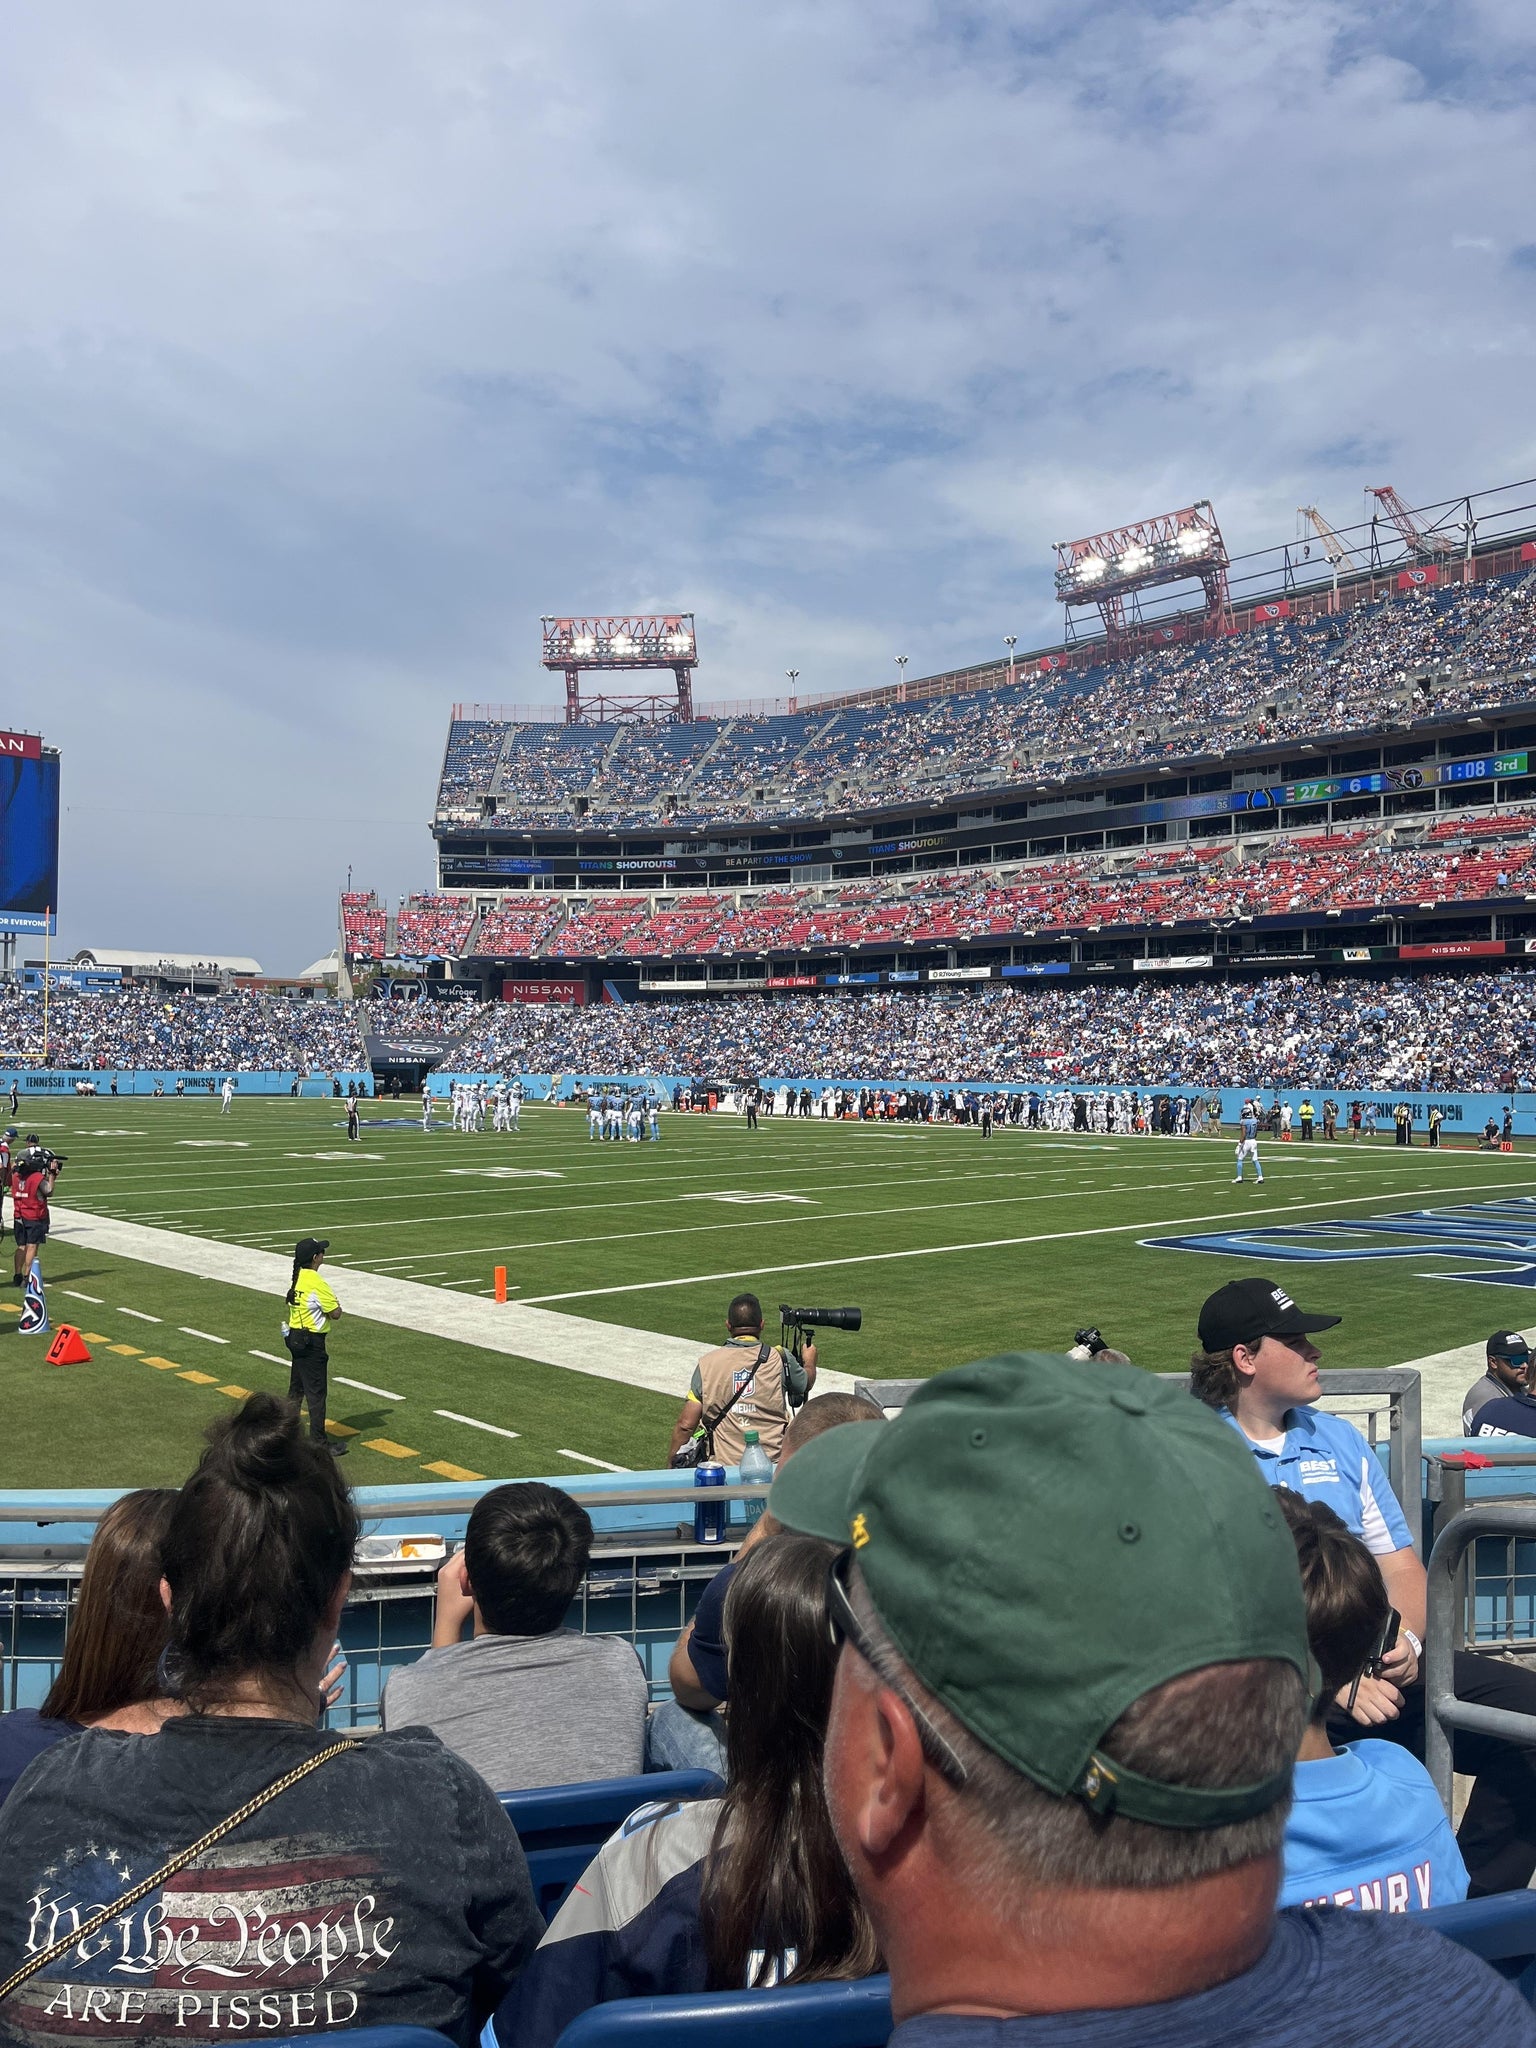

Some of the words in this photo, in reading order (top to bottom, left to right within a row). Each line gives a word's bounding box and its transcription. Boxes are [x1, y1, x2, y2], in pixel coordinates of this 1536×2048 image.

[1435, 760, 1486, 783] 11:08
[1494, 758, 1518, 772] 3rd
[1350, 778, 1361, 793] 6
[1300, 785, 1319, 800] 27
[868, 843, 896, 855] TITANS
[579, 861, 613, 870] TITANS
[616, 860, 677, 870] SHOUTOUTS!
[725, 858, 735, 866] BE
[743, 857, 761, 865] PART
[763, 856, 773, 864] OF
[774, 855, 788, 863] THE
[789, 853, 813, 863] SHOW
[1431, 946, 1471, 954] NISSAN
[449, 984, 478, 999] Kroger
[513, 985, 574, 994] NISSAN
[26, 1076, 65, 1088] TENNESSEE
[182, 1077, 216, 1087] TENNESS
[1502, 1143, 1511, 1151] 10
[1270, 1288, 1287, 1301] BE
[50, 1328, 71, 1358] G
[735, 1381, 752, 1393] NL
[1299, 1459, 1337, 1473] BEST
[1302, 1860, 1432, 1914] NRY
[182, 1895, 401, 1992] People
[43, 1983, 148, 2026] ARE
[174, 1989, 359, 2031] PISSED
